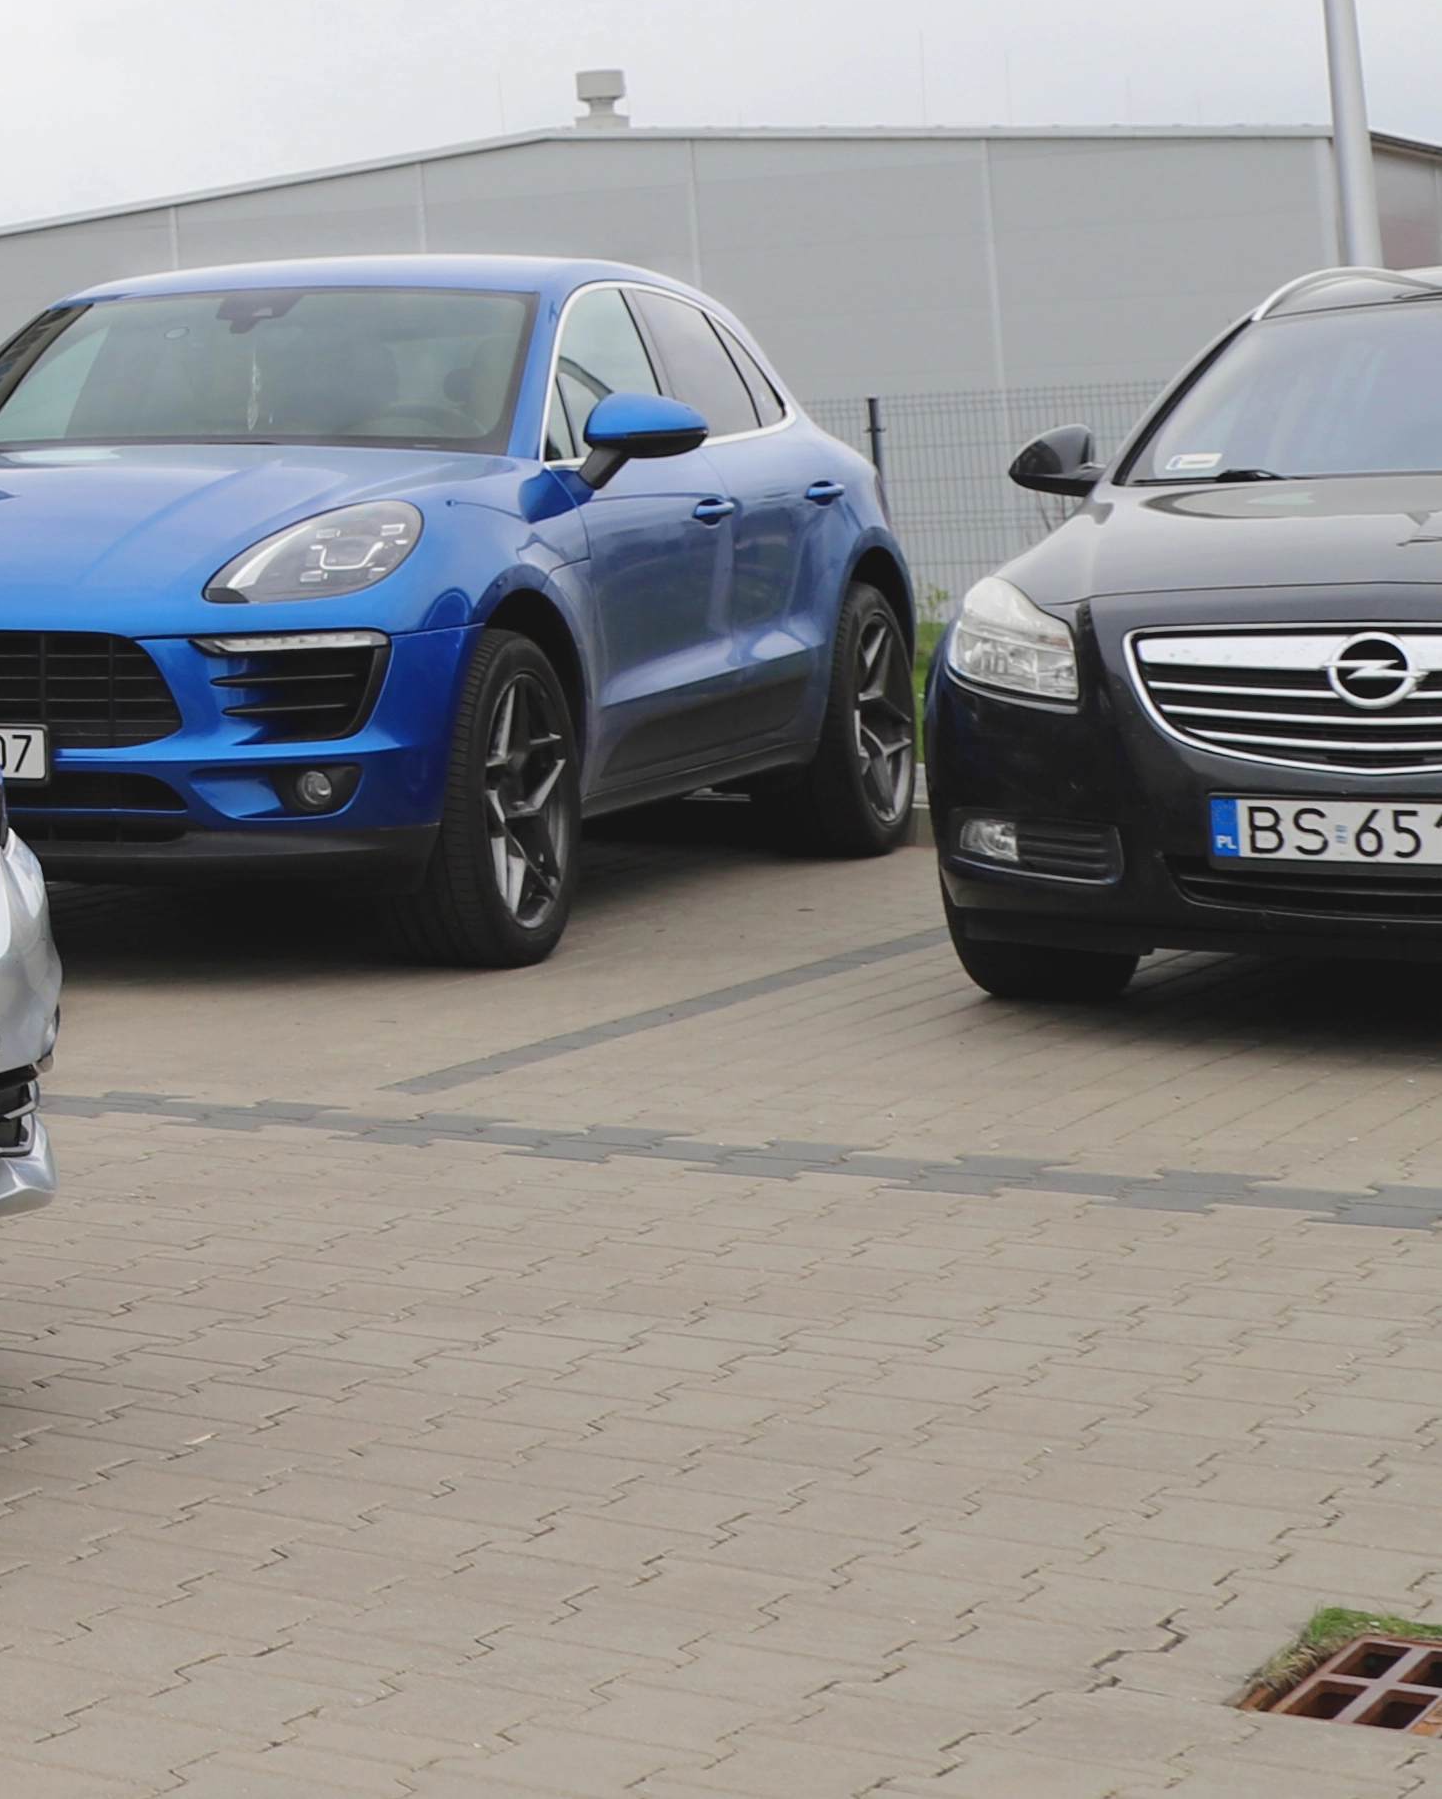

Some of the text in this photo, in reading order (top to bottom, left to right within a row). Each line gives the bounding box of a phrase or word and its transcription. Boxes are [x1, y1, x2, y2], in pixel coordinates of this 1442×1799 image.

[1216, 834, 1237, 850] PL
[1246, 805, 1442, 859] BS 65
